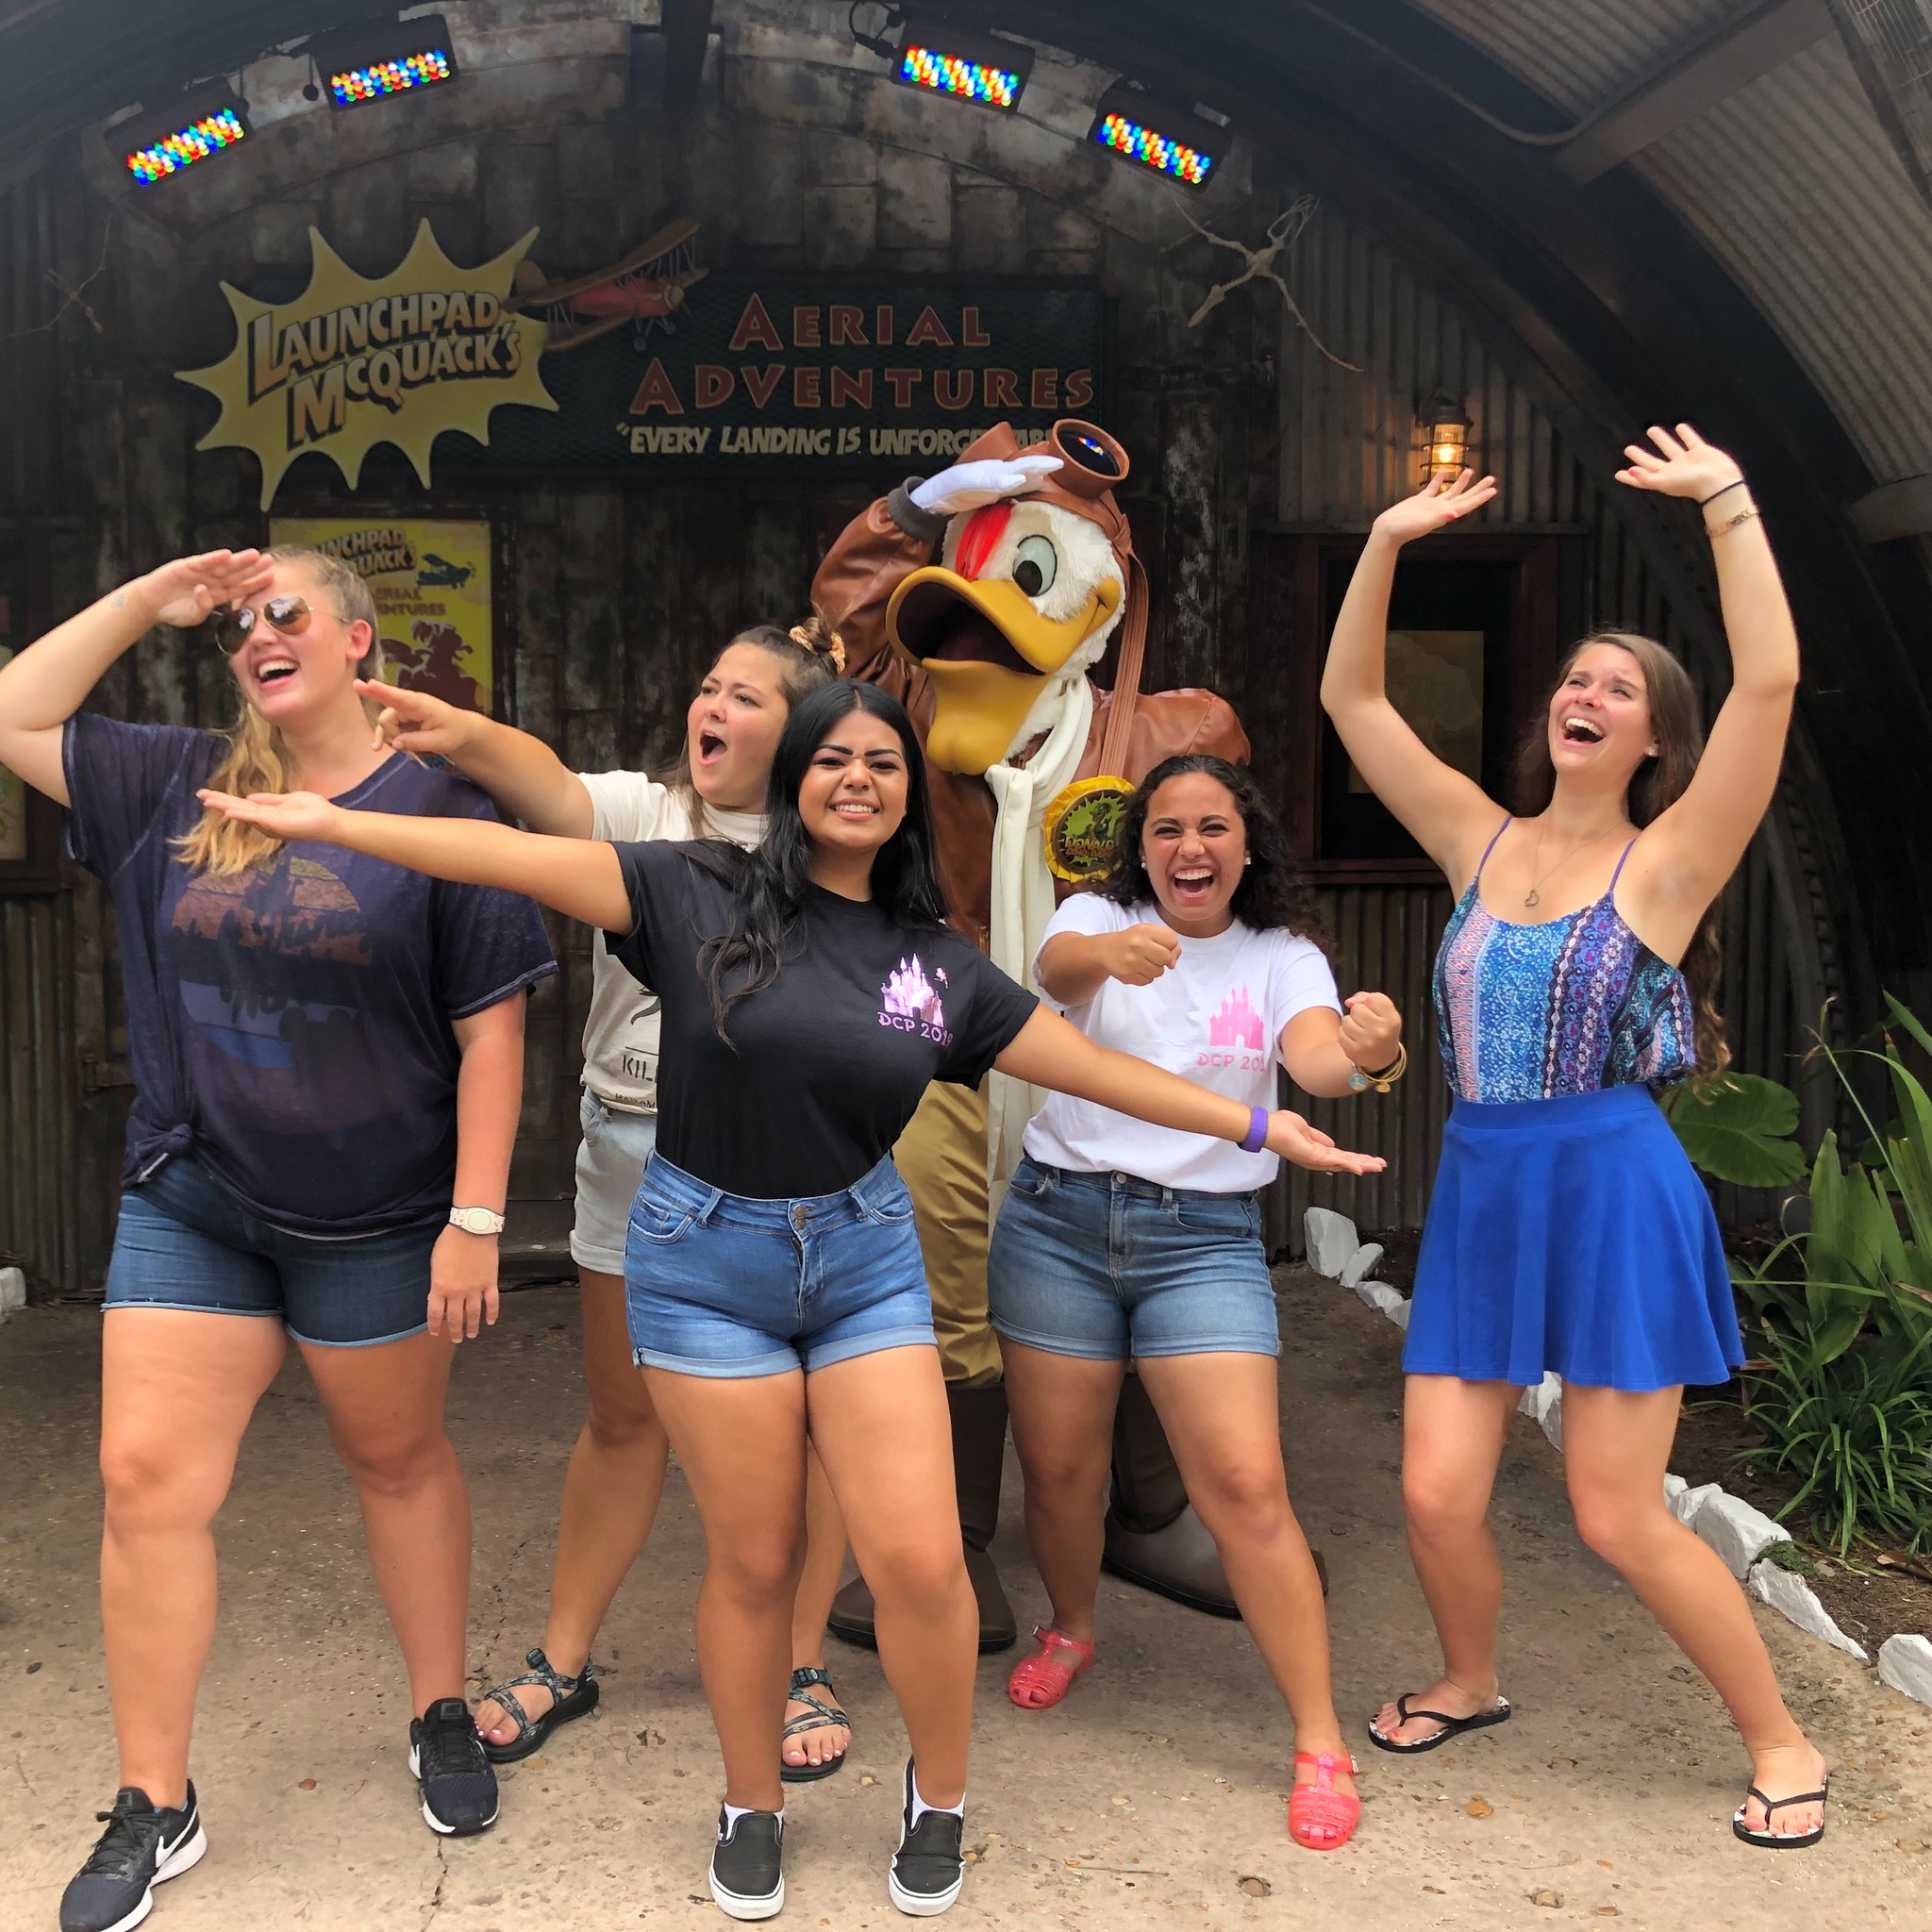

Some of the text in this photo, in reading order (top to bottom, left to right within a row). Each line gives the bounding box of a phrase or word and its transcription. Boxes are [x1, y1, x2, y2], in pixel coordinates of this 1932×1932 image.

[728, 292, 991, 351] AERIAL
[247, 291, 501, 404] LAUNCHPAD
[628, 357, 1094, 415] ADVENTURES
[719, 426, 831, 456] LANDING
[837, 426, 861, 456] IS
[373, 588, 422, 601] ERIAL
[375, 603, 446, 616] ENTURES
[876, 1011, 954, 1047] DCP 2019
[1196, 1052, 1267, 1073] DCP 201
